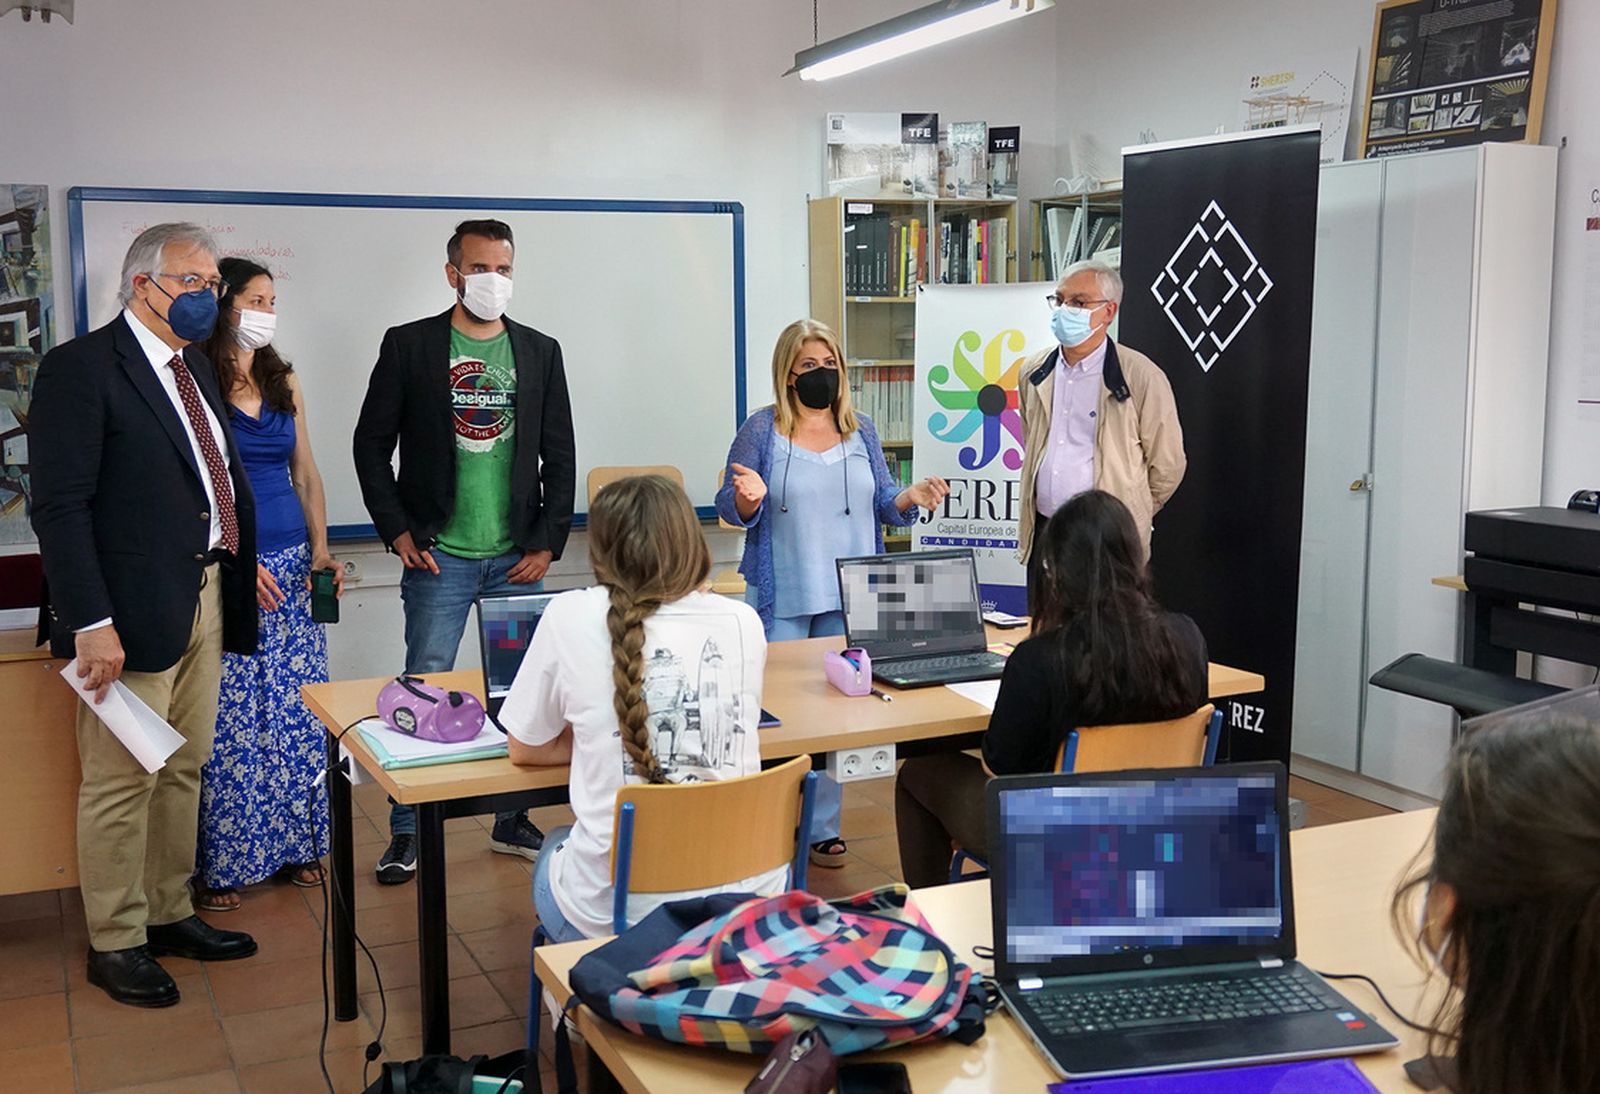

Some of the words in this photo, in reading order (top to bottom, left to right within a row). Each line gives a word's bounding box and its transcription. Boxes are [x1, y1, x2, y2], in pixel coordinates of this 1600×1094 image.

[908, 128, 931, 138] TFE
[995, 139, 1015, 148] TFE
[487, 366, 512, 386] CHULA
[937, 522, 967, 536] Capital
[968, 524, 1003, 537] Europea
[1005, 526, 1017, 537] de
[1228, 701, 1265, 734] REZ
